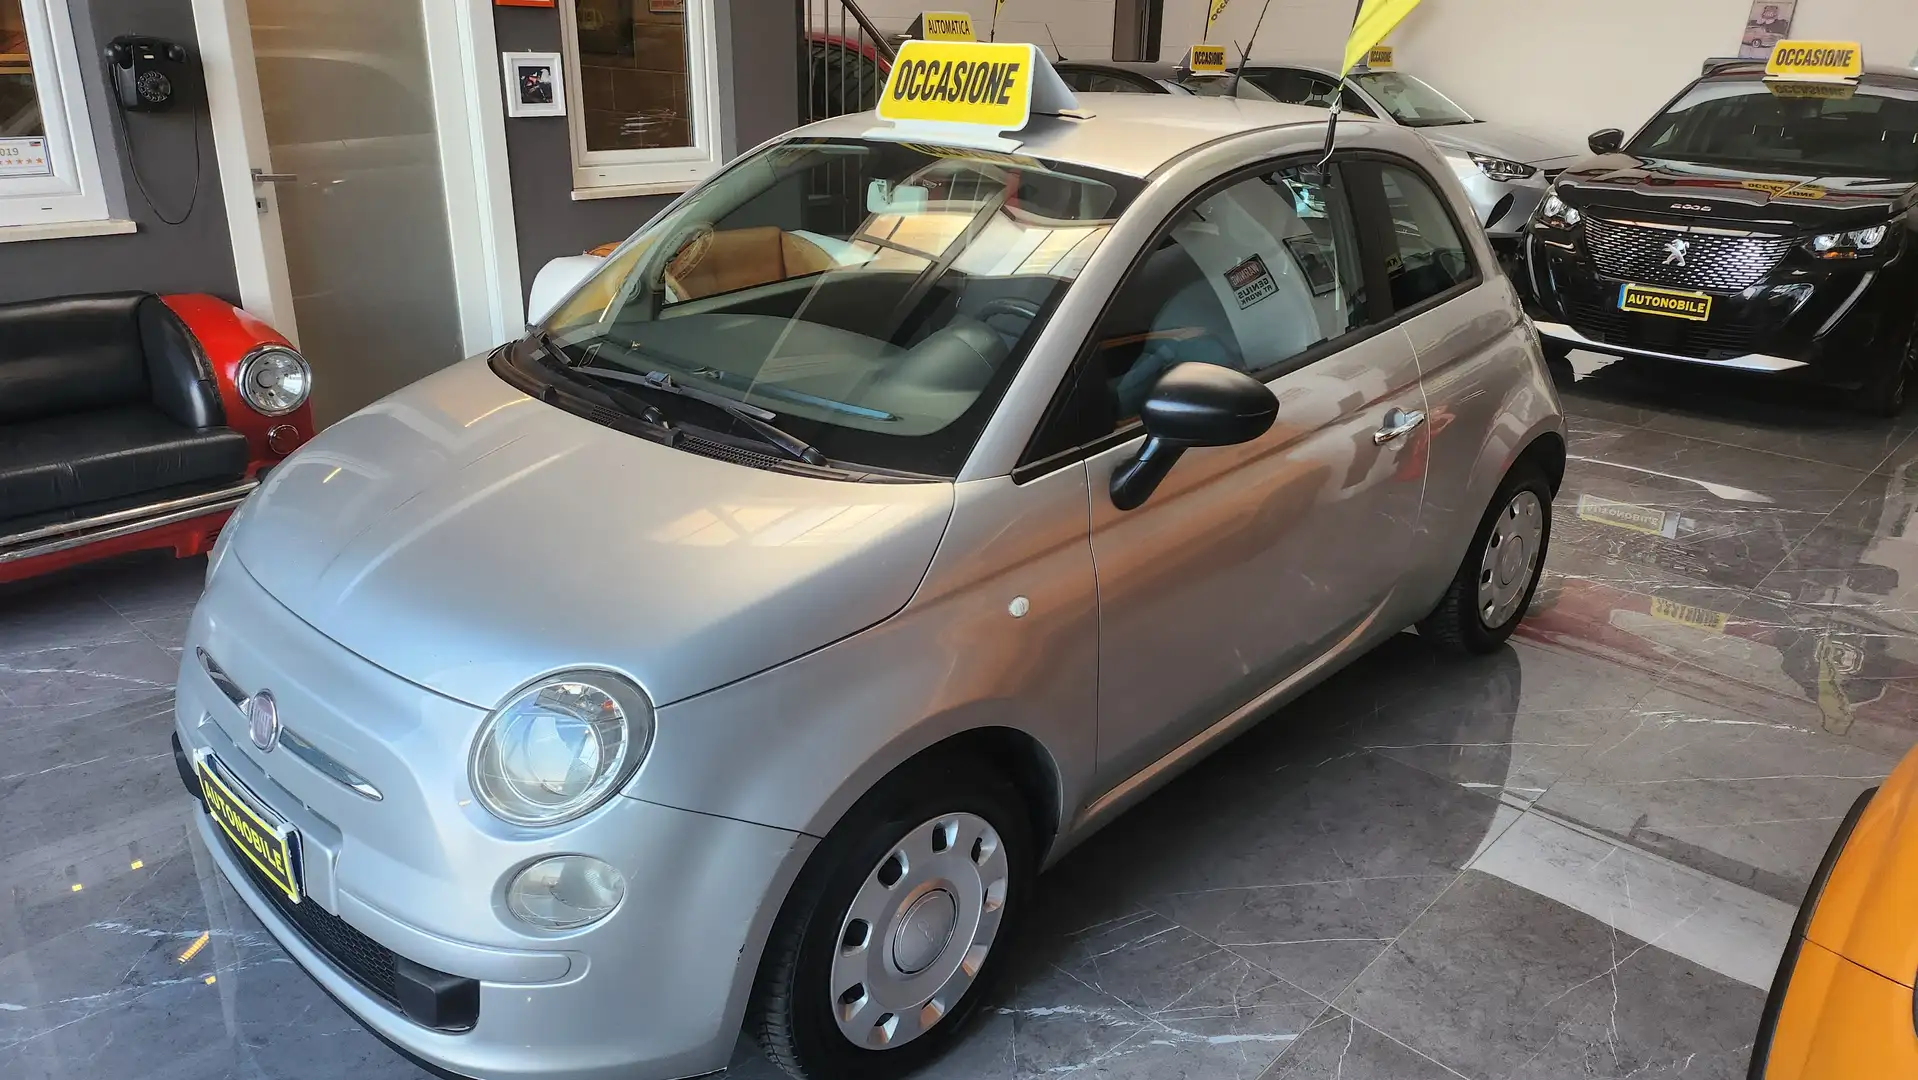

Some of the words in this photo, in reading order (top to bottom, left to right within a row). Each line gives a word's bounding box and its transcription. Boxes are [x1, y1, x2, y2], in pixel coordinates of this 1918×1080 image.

[928, 19, 971, 35] AUTOMATICA
[1194, 51, 1224, 65] OCCASIONE
[1775, 48, 1854, 67] OCCASIONE
[893, 59, 1020, 105] OCCASIONE
[1627, 293, 1706, 313] AUTONOBILE
